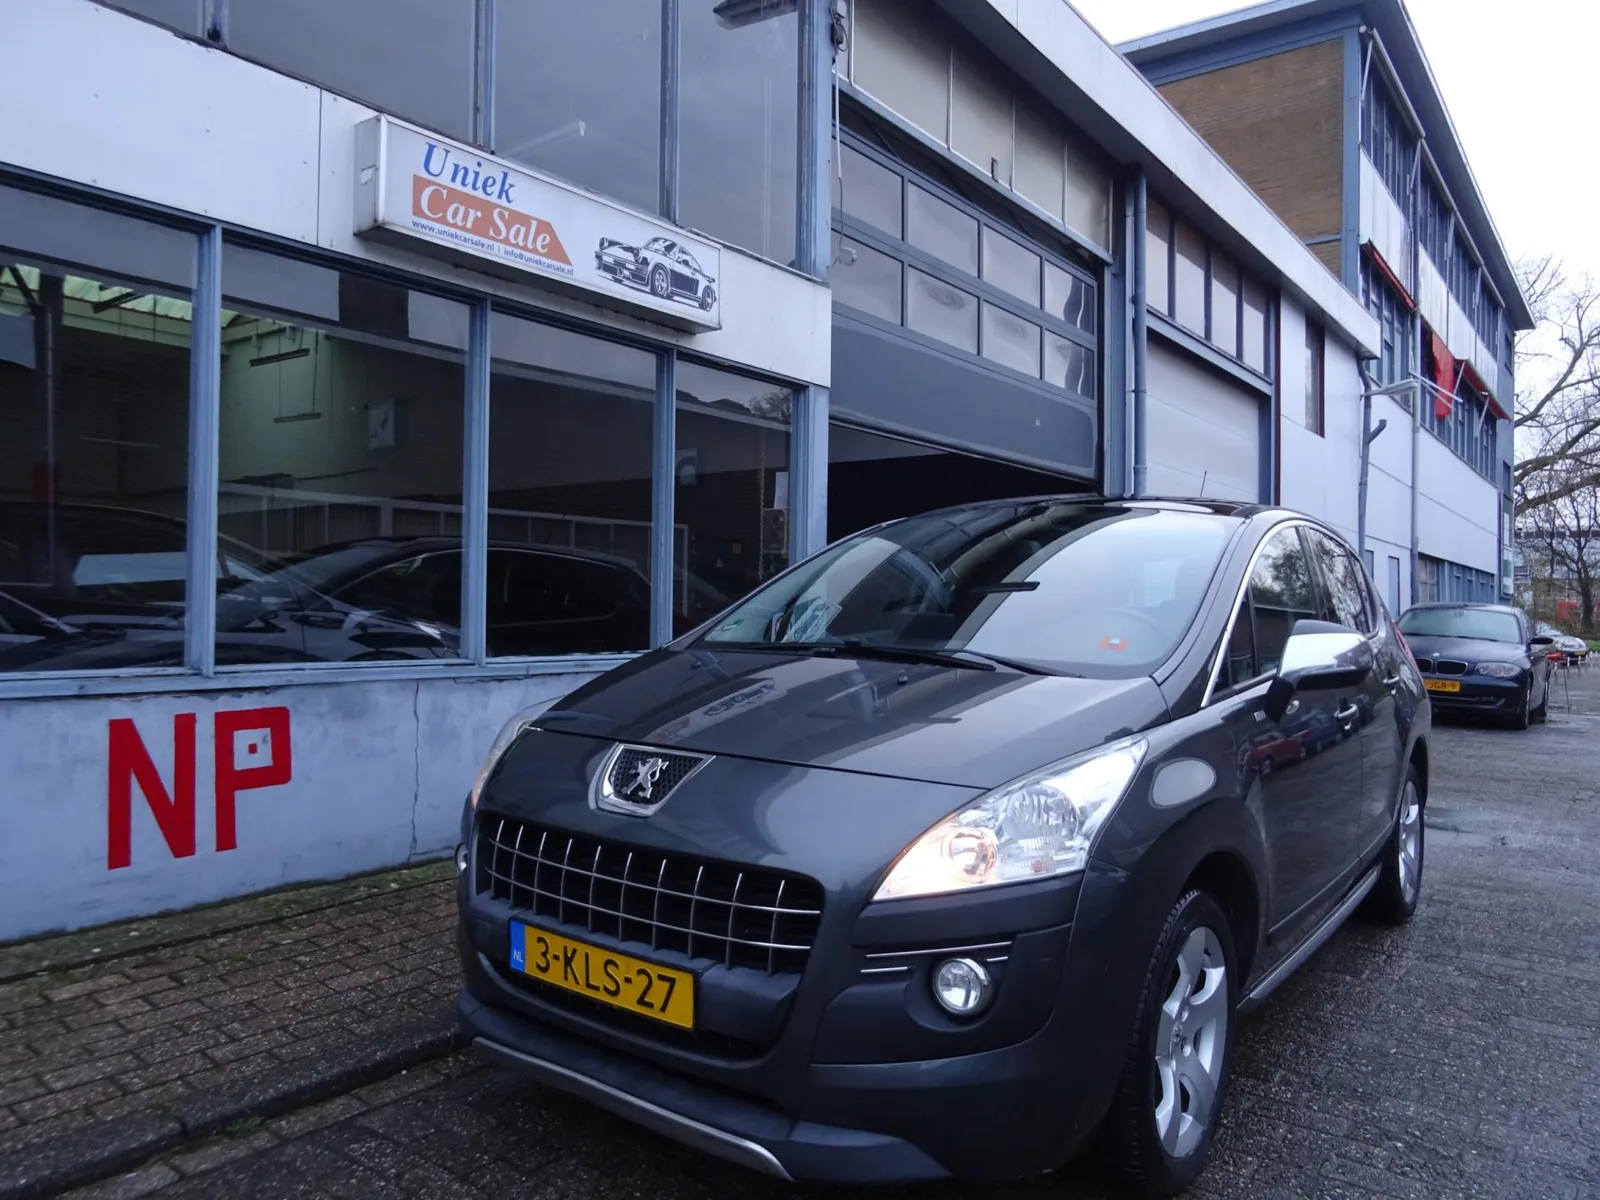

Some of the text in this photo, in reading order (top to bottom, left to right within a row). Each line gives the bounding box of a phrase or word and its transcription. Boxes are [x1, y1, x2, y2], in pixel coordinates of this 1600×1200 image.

[423, 141, 516, 204] Uniek
[412, 220, 574, 276] www.uniekcarsale.nl info@uniekcarsale.nl
[420, 184, 551, 254] Car Sale
[107, 705, 292, 870] NP
[513, 948, 524, 963] NL
[535, 936, 677, 1013] 3-KLS-27
